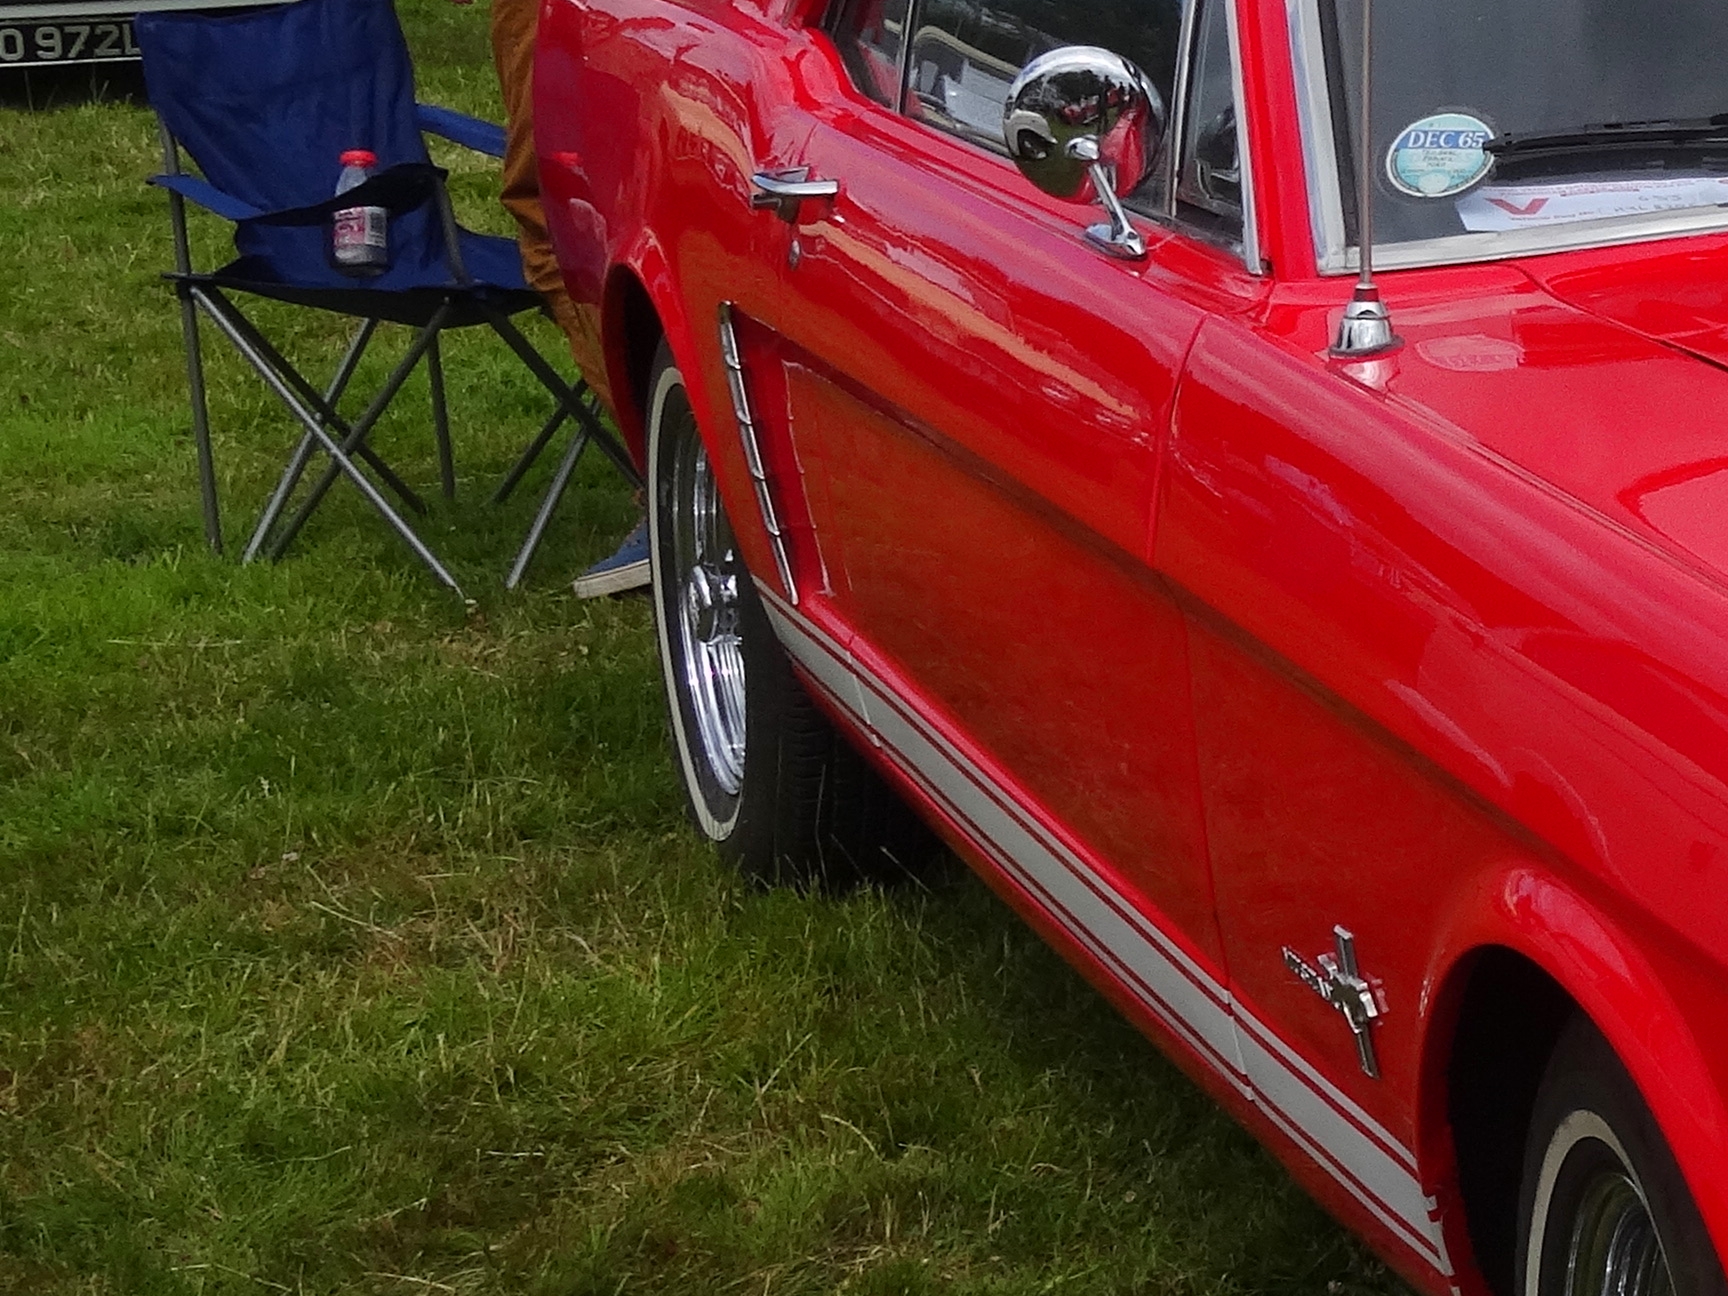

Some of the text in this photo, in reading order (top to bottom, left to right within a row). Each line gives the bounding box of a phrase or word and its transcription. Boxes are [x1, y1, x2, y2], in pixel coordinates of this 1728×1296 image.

[34, 23, 140, 60] 972L
[1407, 131, 1485, 148] DEC 65
